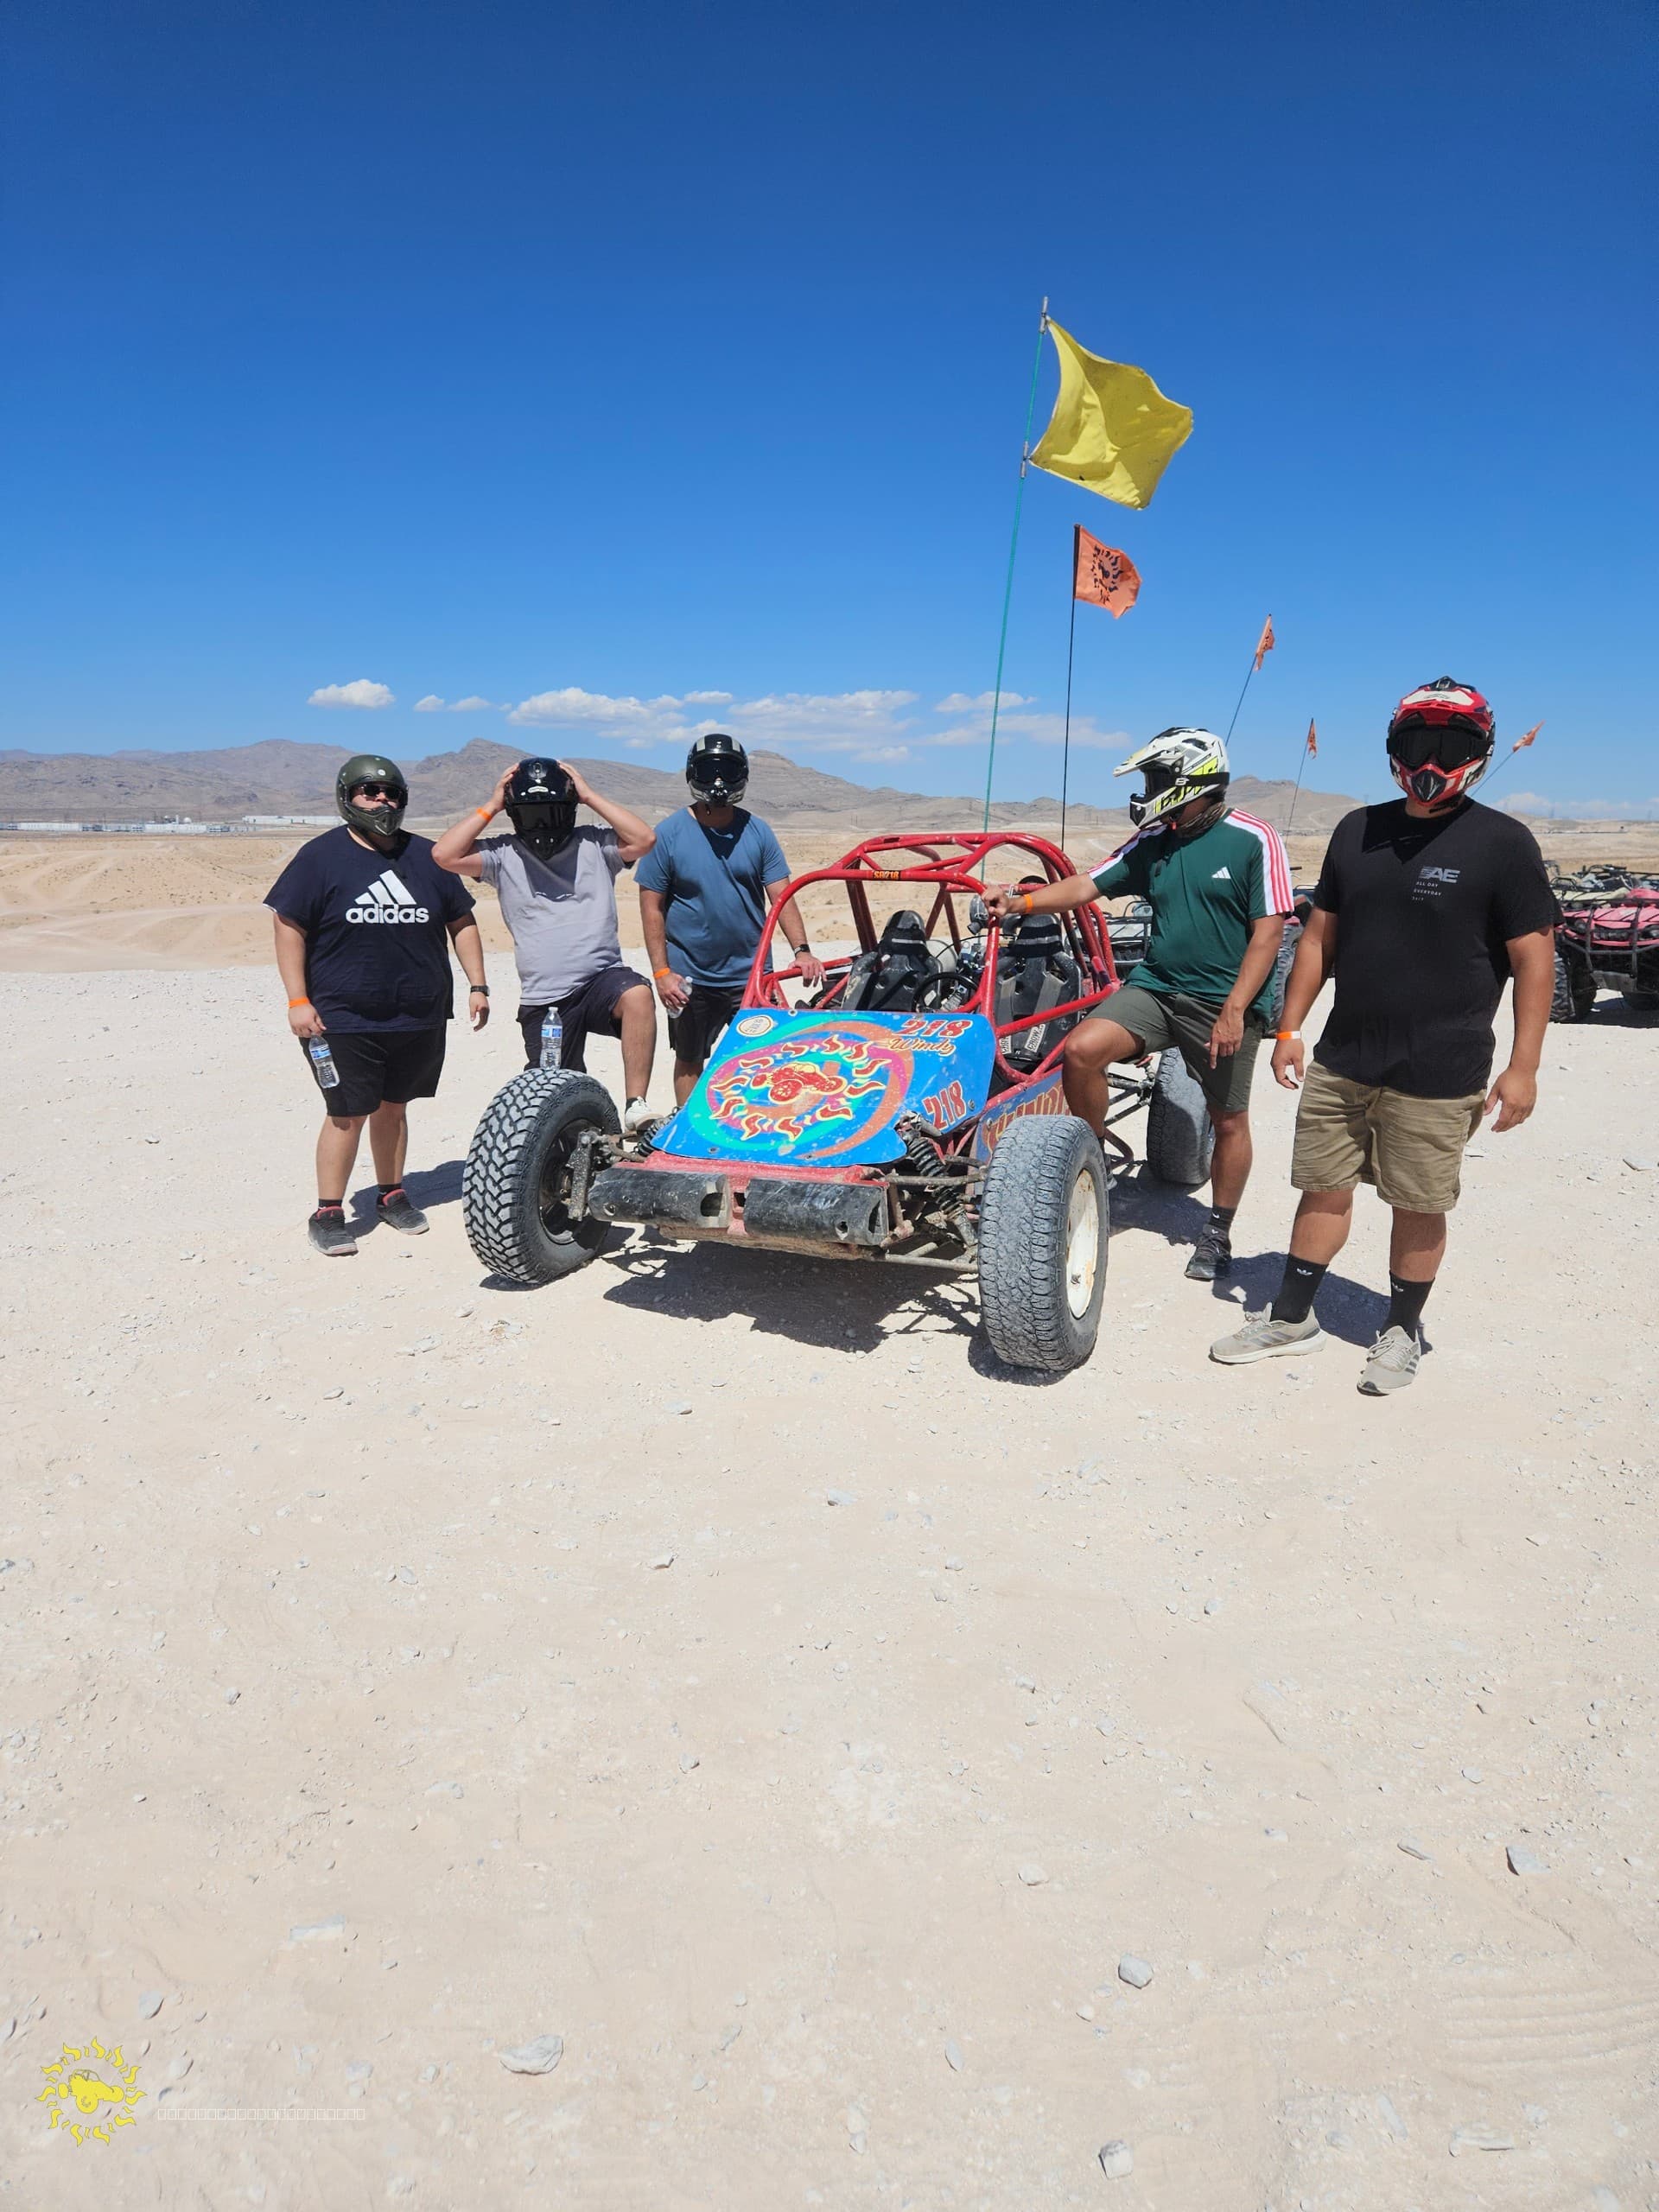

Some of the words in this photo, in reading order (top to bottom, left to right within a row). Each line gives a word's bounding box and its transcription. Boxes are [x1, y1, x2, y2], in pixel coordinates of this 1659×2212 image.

[346, 903, 429, 924] adidas
[892, 1020, 974, 1038] 218
[888, 1038, 957, 1056] Windy
[921, 1080, 967, 1130] 218
